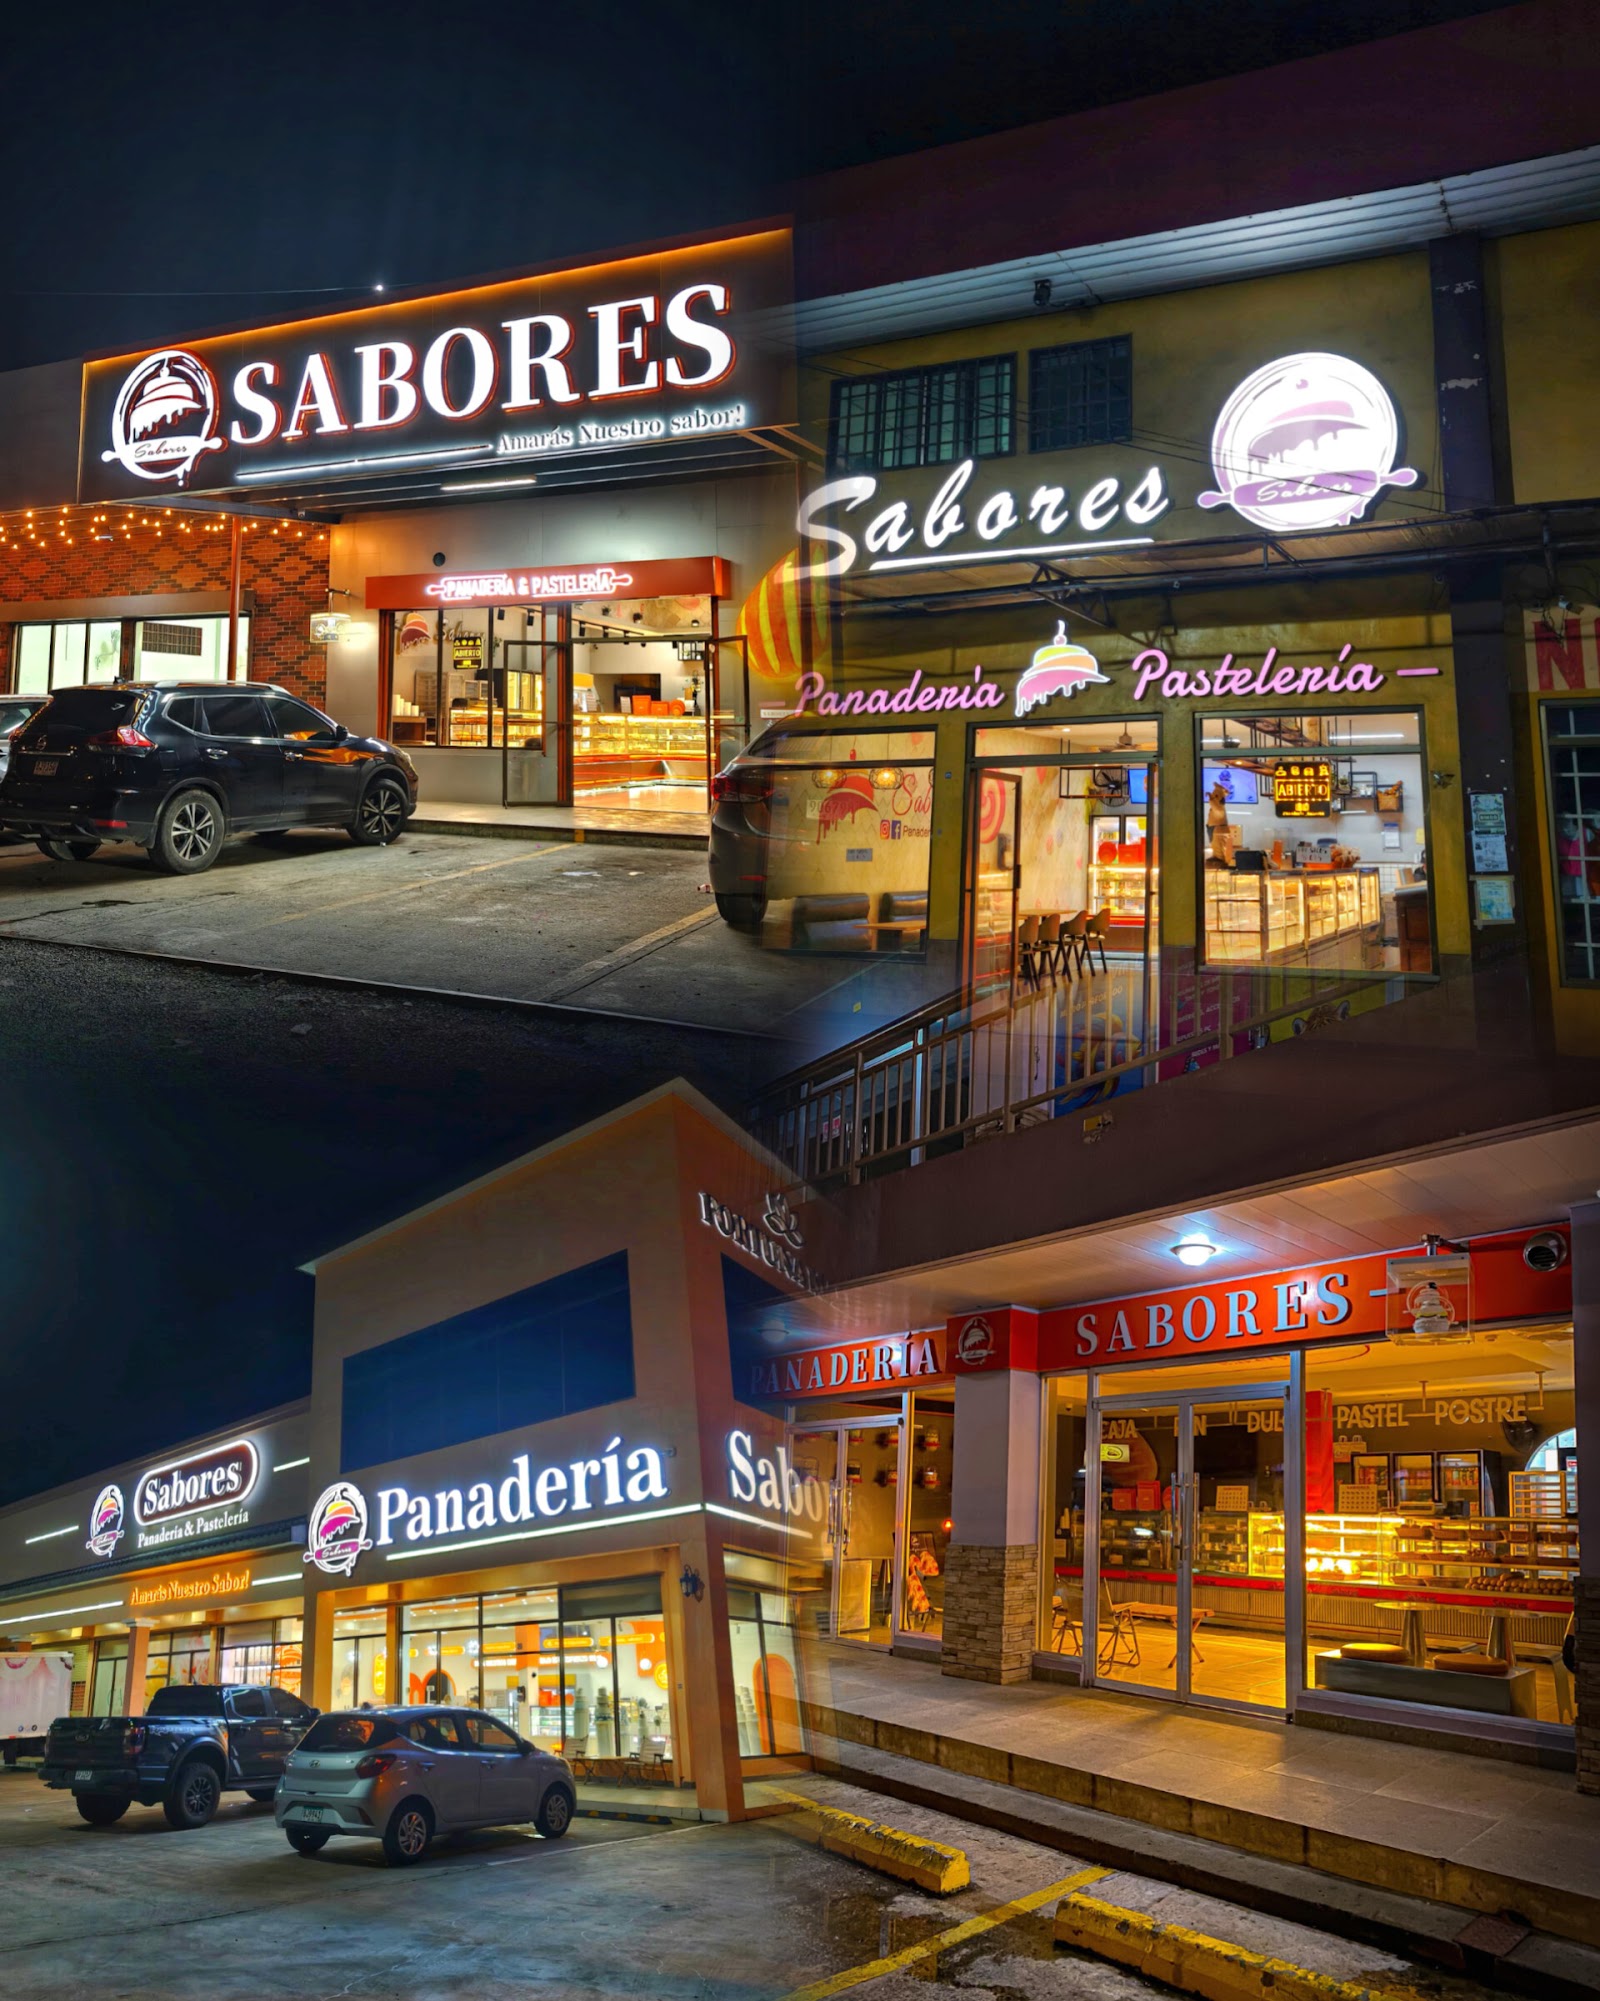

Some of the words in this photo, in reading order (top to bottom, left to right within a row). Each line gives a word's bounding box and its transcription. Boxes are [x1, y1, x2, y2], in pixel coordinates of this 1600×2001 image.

[231, 283, 734, 445] SABORES
[135, 440, 187, 458] Sabores
[498, 425, 571, 453] Amarás
[579, 418, 662, 443] Nuestro
[670, 404, 743, 432] sabor!
[782, 459, 1169, 580] Sabores
[795, 665, 1005, 716] Panadería
[1133, 643, 1385, 700] Pastelería
[1278, 783, 1327, 796] ABIERTO
[1076, 1273, 1350, 1355] SABORES
[751, 1332, 939, 1394] PANADERÍA
[1173, 1415, 1207, 1436] PN
[1337, 1403, 1409, 1429] PASTEL
[1434, 1396, 1528, 1425] POSTRE
[144, 1461, 242, 1516] Sabores
[376, 1436, 668, 1547] Panadería
[137, 1524, 183, 1548] Panadería
[184, 1523, 195, 1536] &
[196, 1509, 249, 1534] Pastelería
[167, 1580, 210, 1599] Nuestro
[211, 1570, 249, 1595] Sabor!
